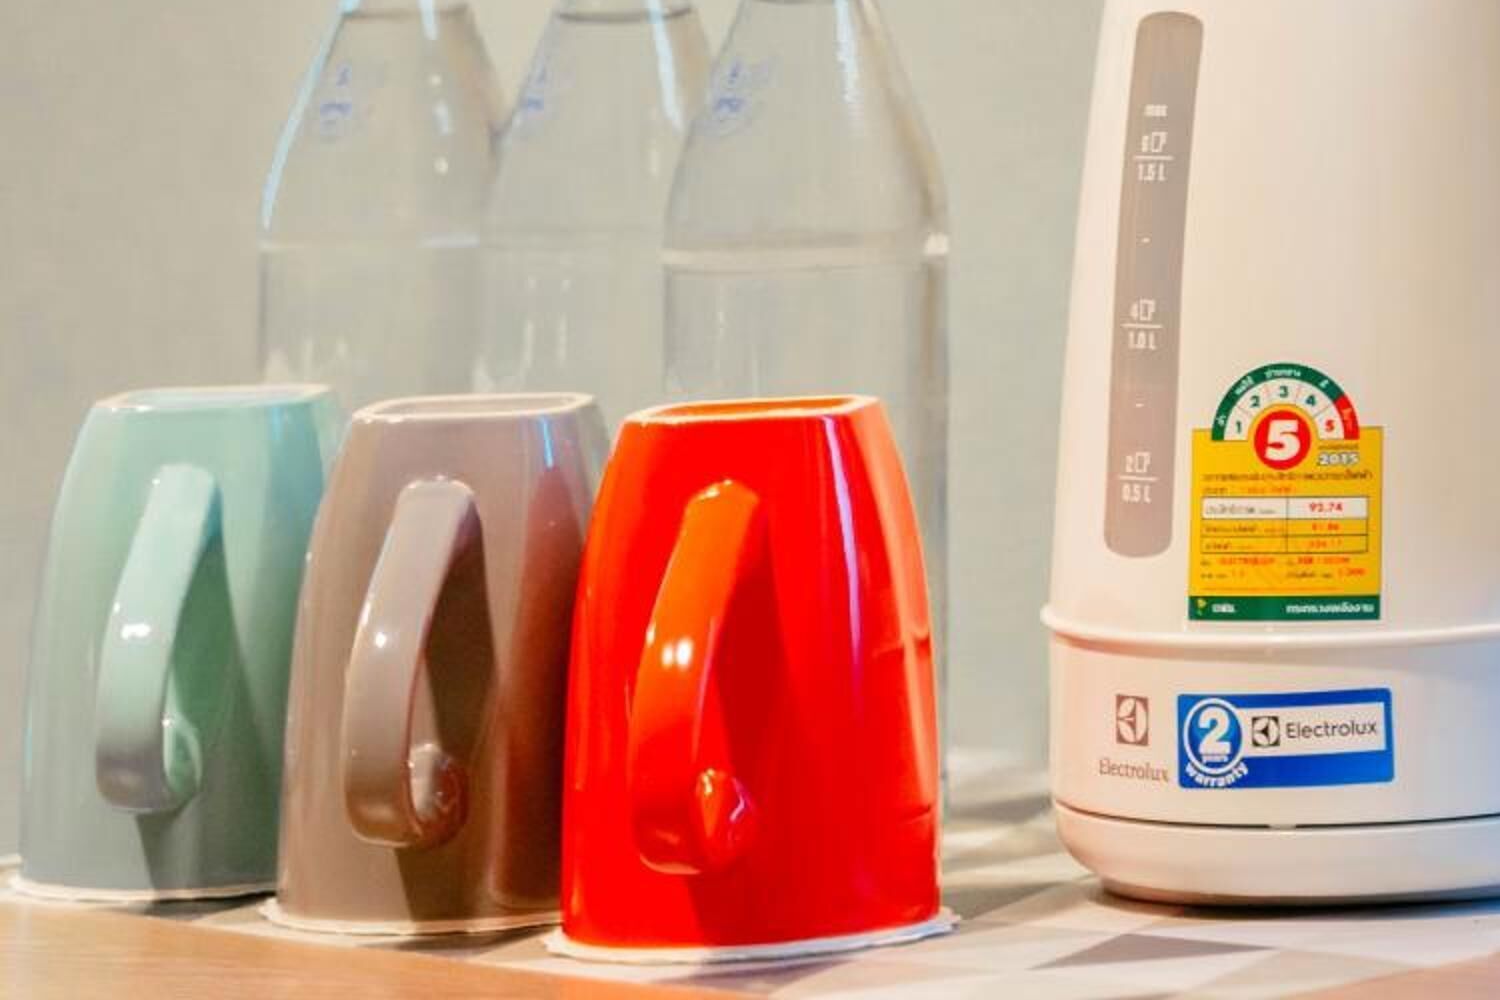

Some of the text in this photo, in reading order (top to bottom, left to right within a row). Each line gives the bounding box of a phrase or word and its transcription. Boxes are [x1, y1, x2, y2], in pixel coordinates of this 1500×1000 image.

[1278, 385, 1289, 398] 3
[1305, 394, 1317, 406] 4
[1250, 395, 1260, 408] 2
[1236, 420, 1242, 434] 1
[1325, 419, 1335, 432] 5
[1264, 418, 1301, 461] 5
[1198, 706, 1231, 756] 2
[1286, 719, 1377, 739] Electrolux
[1099, 757, 1169, 783] Electrolux
[1185, 761, 1249, 788] warranty
